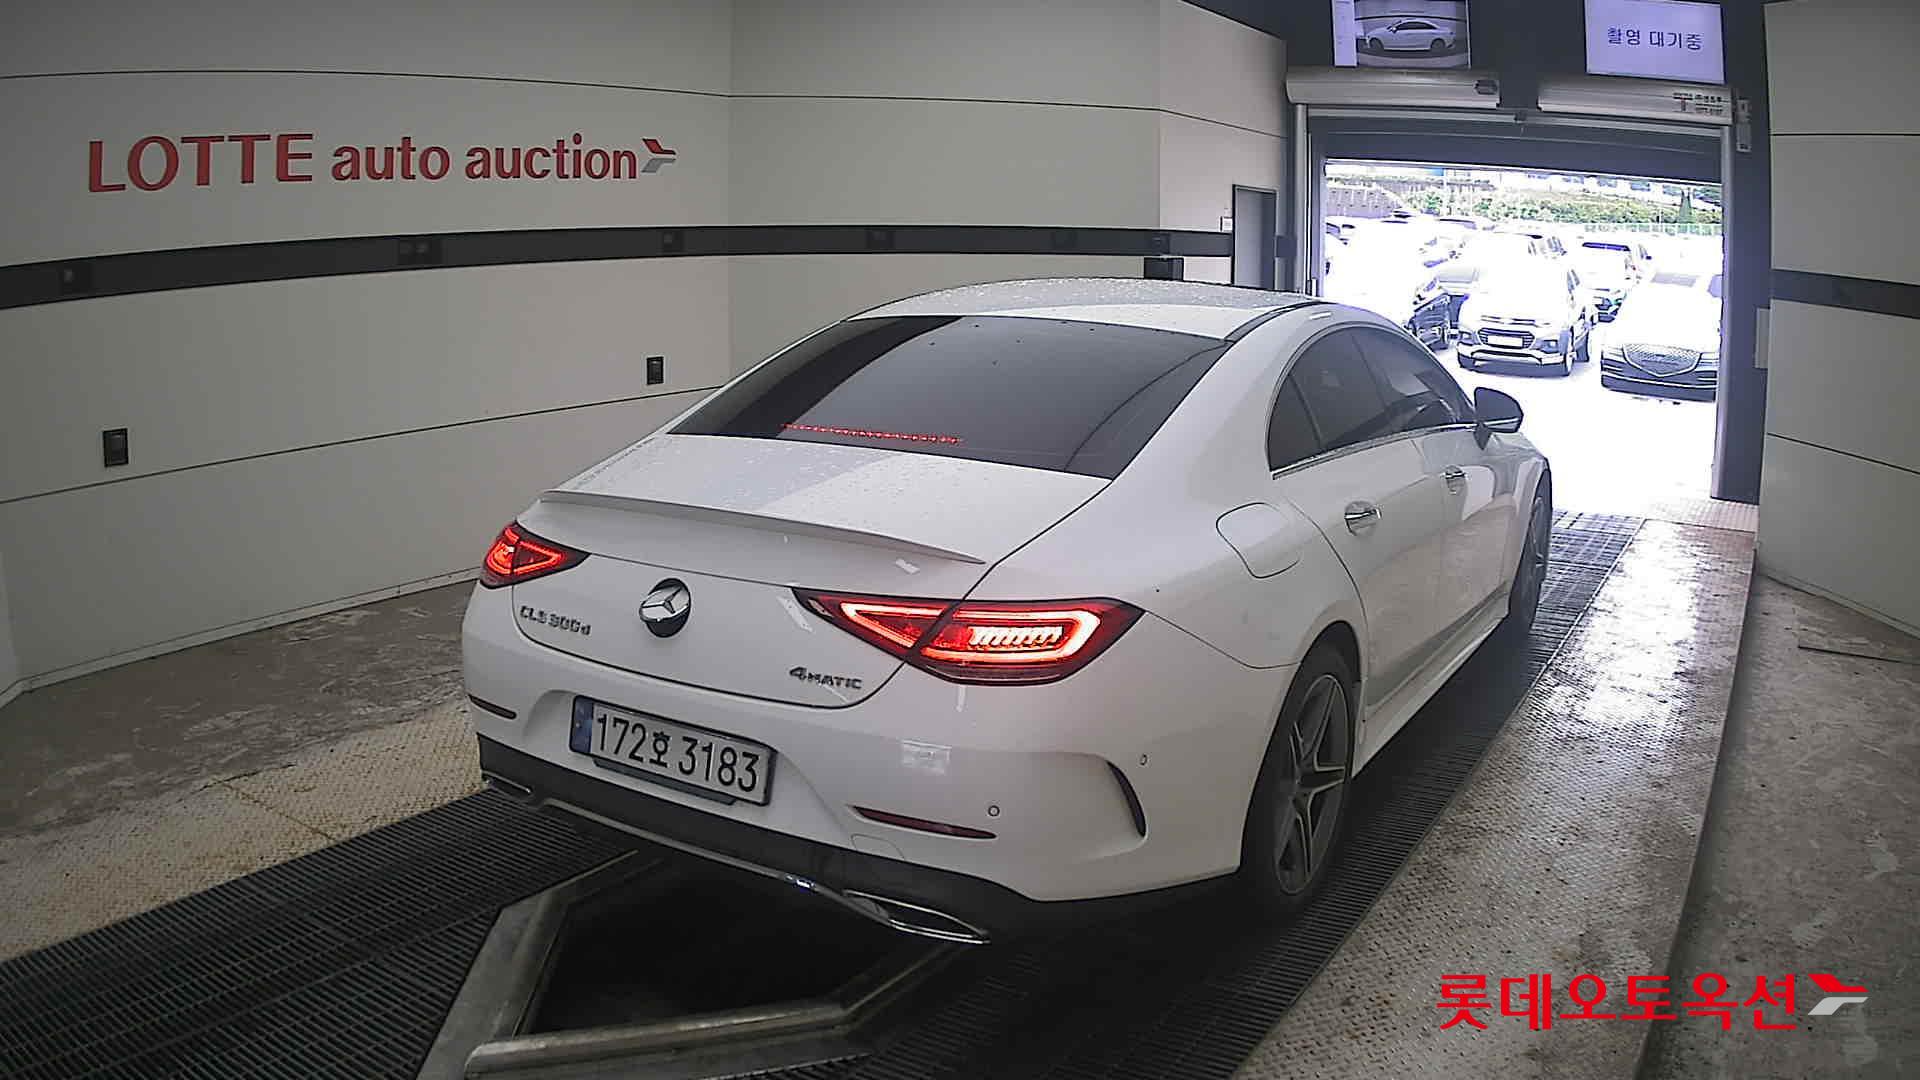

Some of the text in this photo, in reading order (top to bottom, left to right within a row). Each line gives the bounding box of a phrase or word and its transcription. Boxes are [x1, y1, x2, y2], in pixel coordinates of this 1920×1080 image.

[1607, 27, 1702, 51] 촬영 대기중
[88, 133, 639, 193] LOTTE auto auction
[678, 735, 759, 792] 3183
